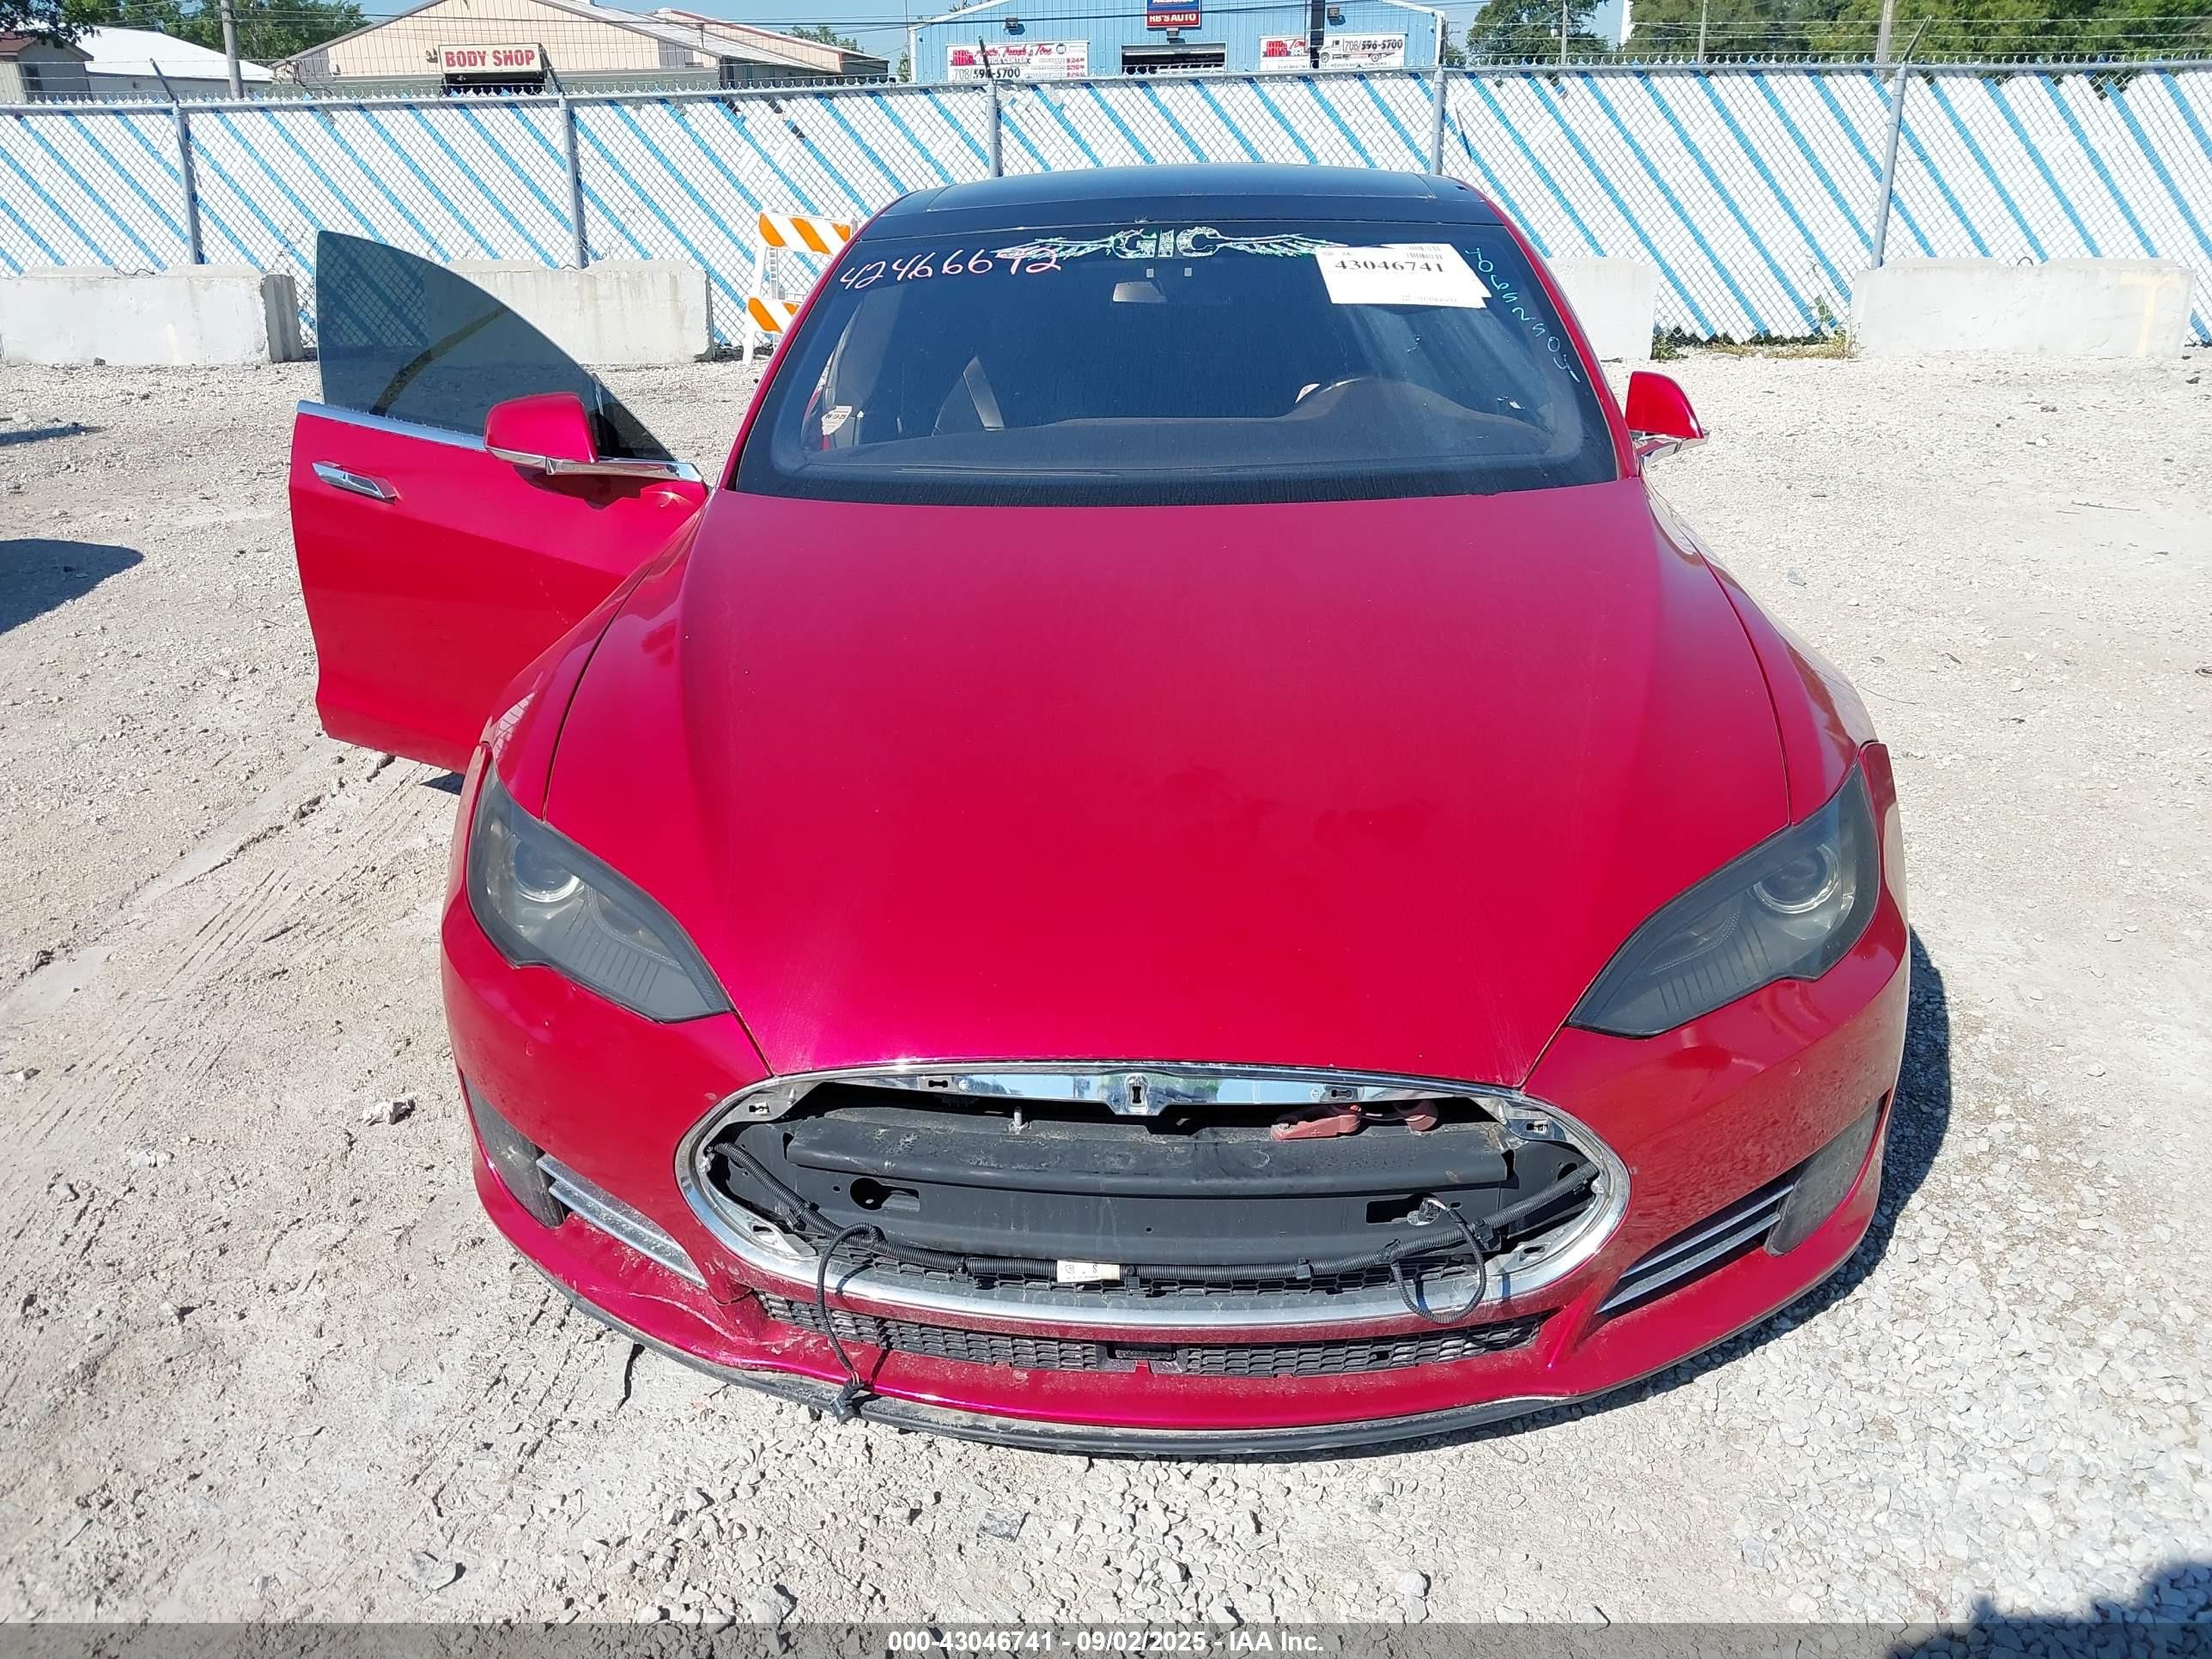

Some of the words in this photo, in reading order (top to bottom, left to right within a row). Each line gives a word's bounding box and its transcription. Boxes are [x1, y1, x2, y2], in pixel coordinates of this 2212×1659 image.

[1171, 13, 1198, 22] AUTO
[1345, 39, 1403, 52] 708/596-5700
[444, 51, 487, 67] BODY
[492, 49, 535, 66] SHOP
[1334, 259, 1443, 272] 43046741
